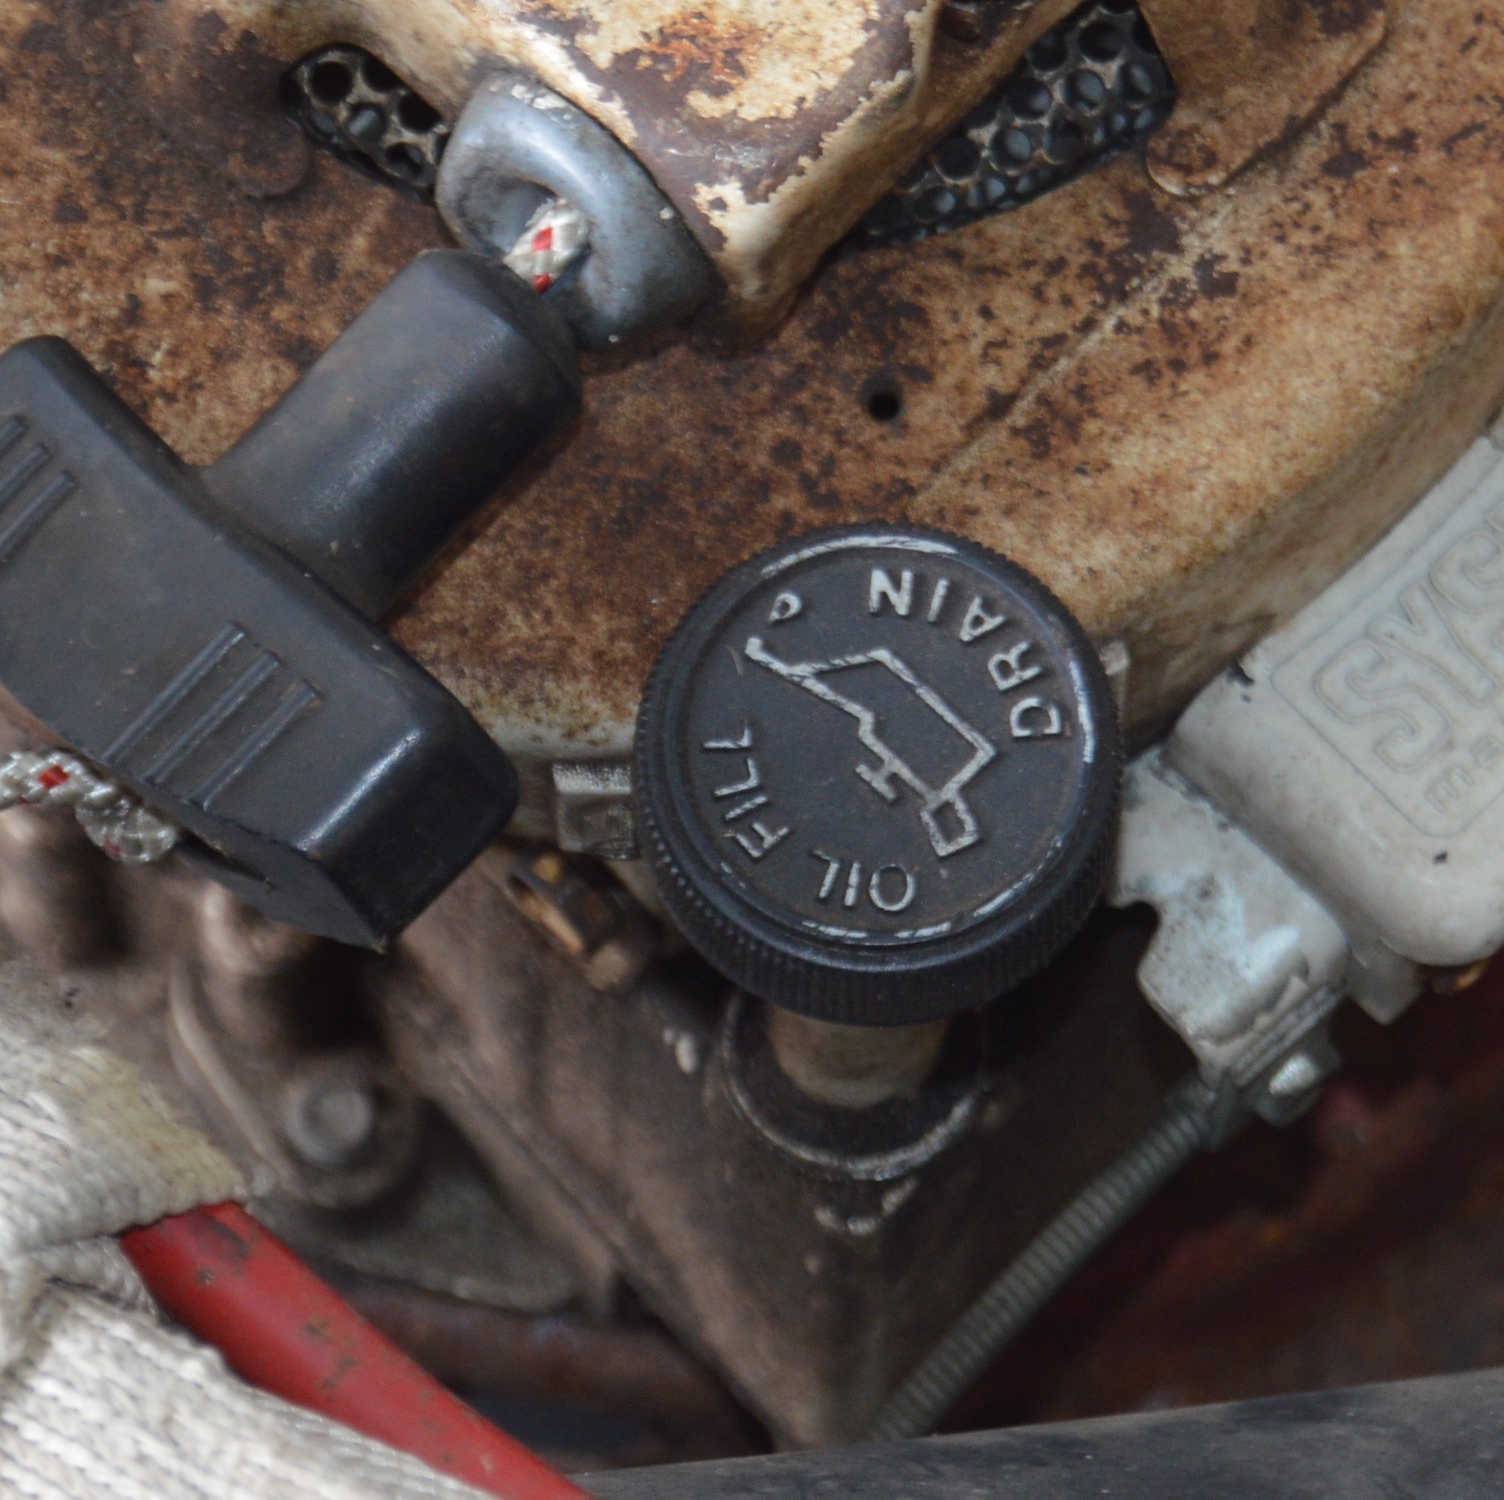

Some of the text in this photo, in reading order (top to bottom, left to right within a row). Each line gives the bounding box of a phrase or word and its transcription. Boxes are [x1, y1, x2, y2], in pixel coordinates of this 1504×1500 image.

[867, 567, 1064, 740] DRAIN
[703, 721, 916, 912] OIL FILL
